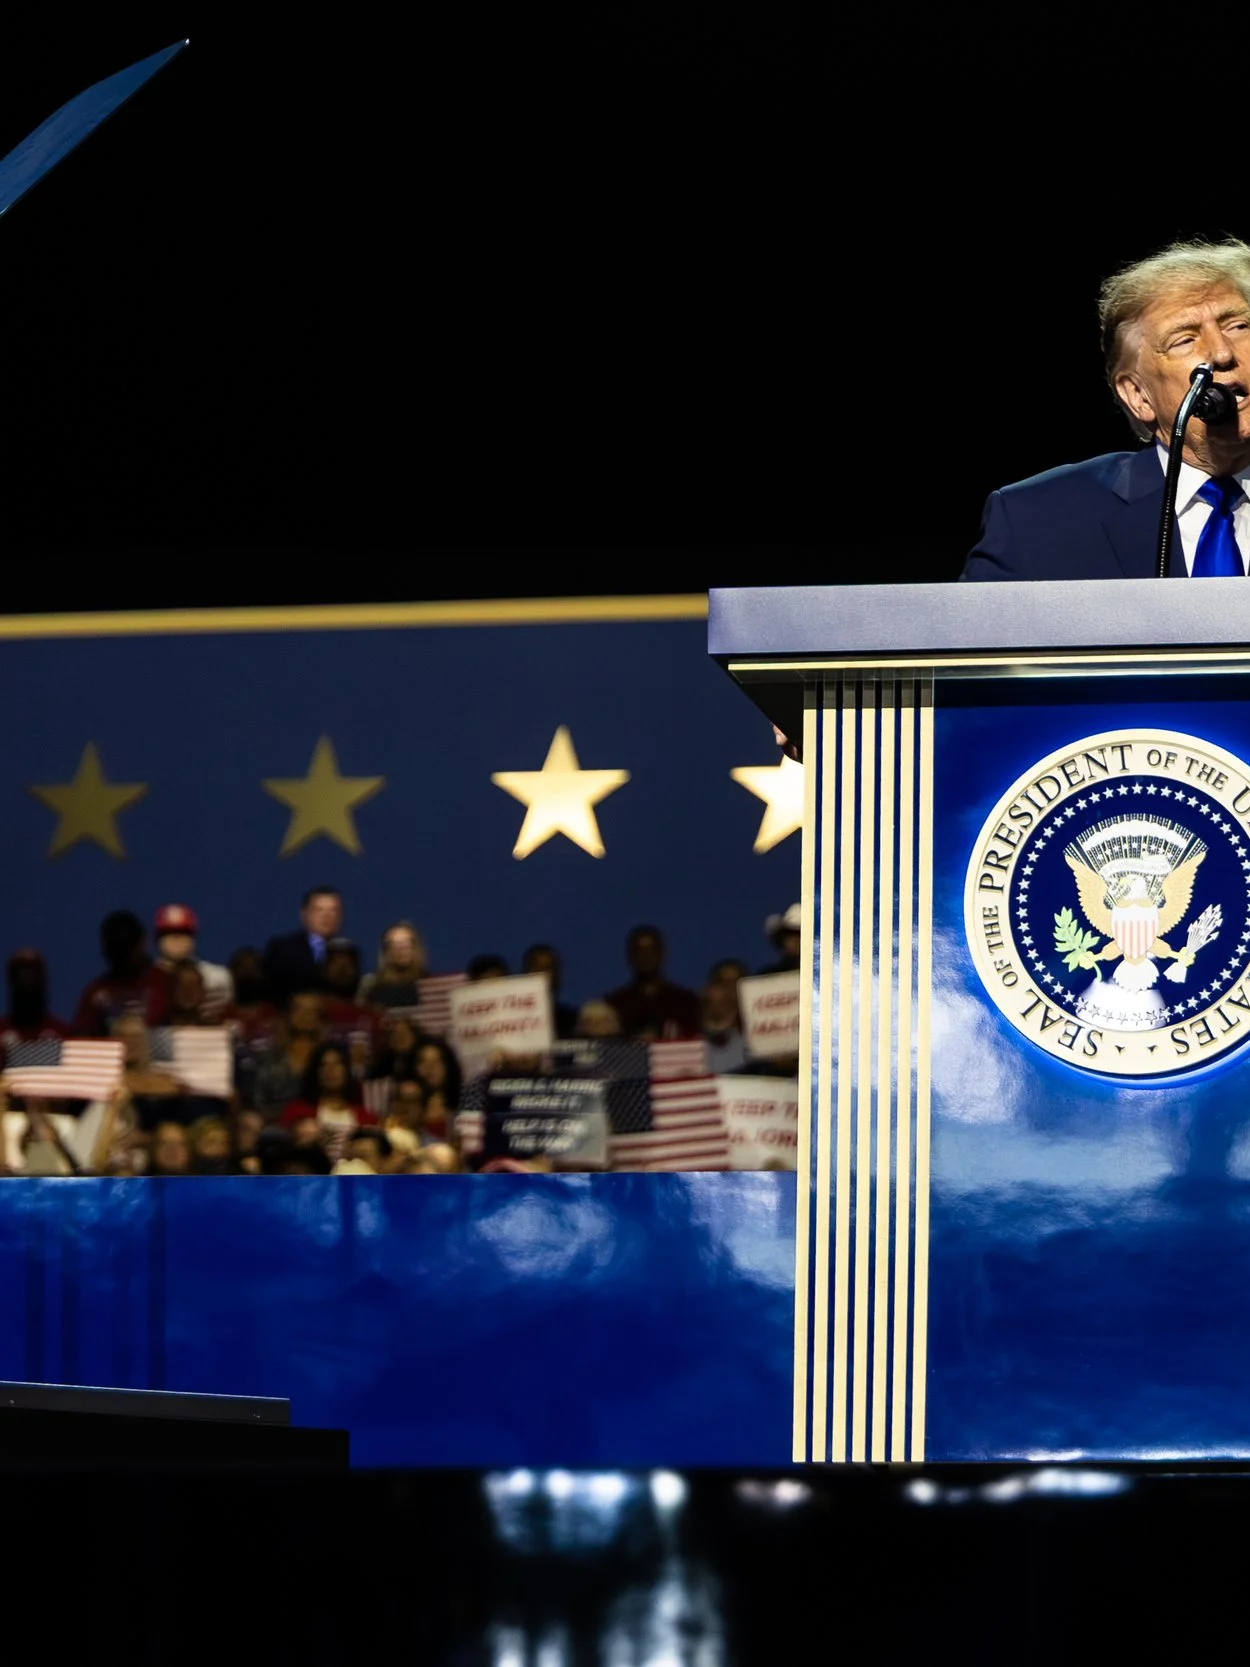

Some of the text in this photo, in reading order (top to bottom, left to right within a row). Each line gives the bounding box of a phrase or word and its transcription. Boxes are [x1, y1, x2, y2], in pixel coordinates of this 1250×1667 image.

[1147, 749, 1178, 770] OF
[1185, 758, 1228, 790] THE
[979, 744, 1132, 895] PRESIDENT
[982, 904, 1003, 955] THE
[993, 958, 1018, 987] OF
[1019, 988, 1103, 1056] SEAL
